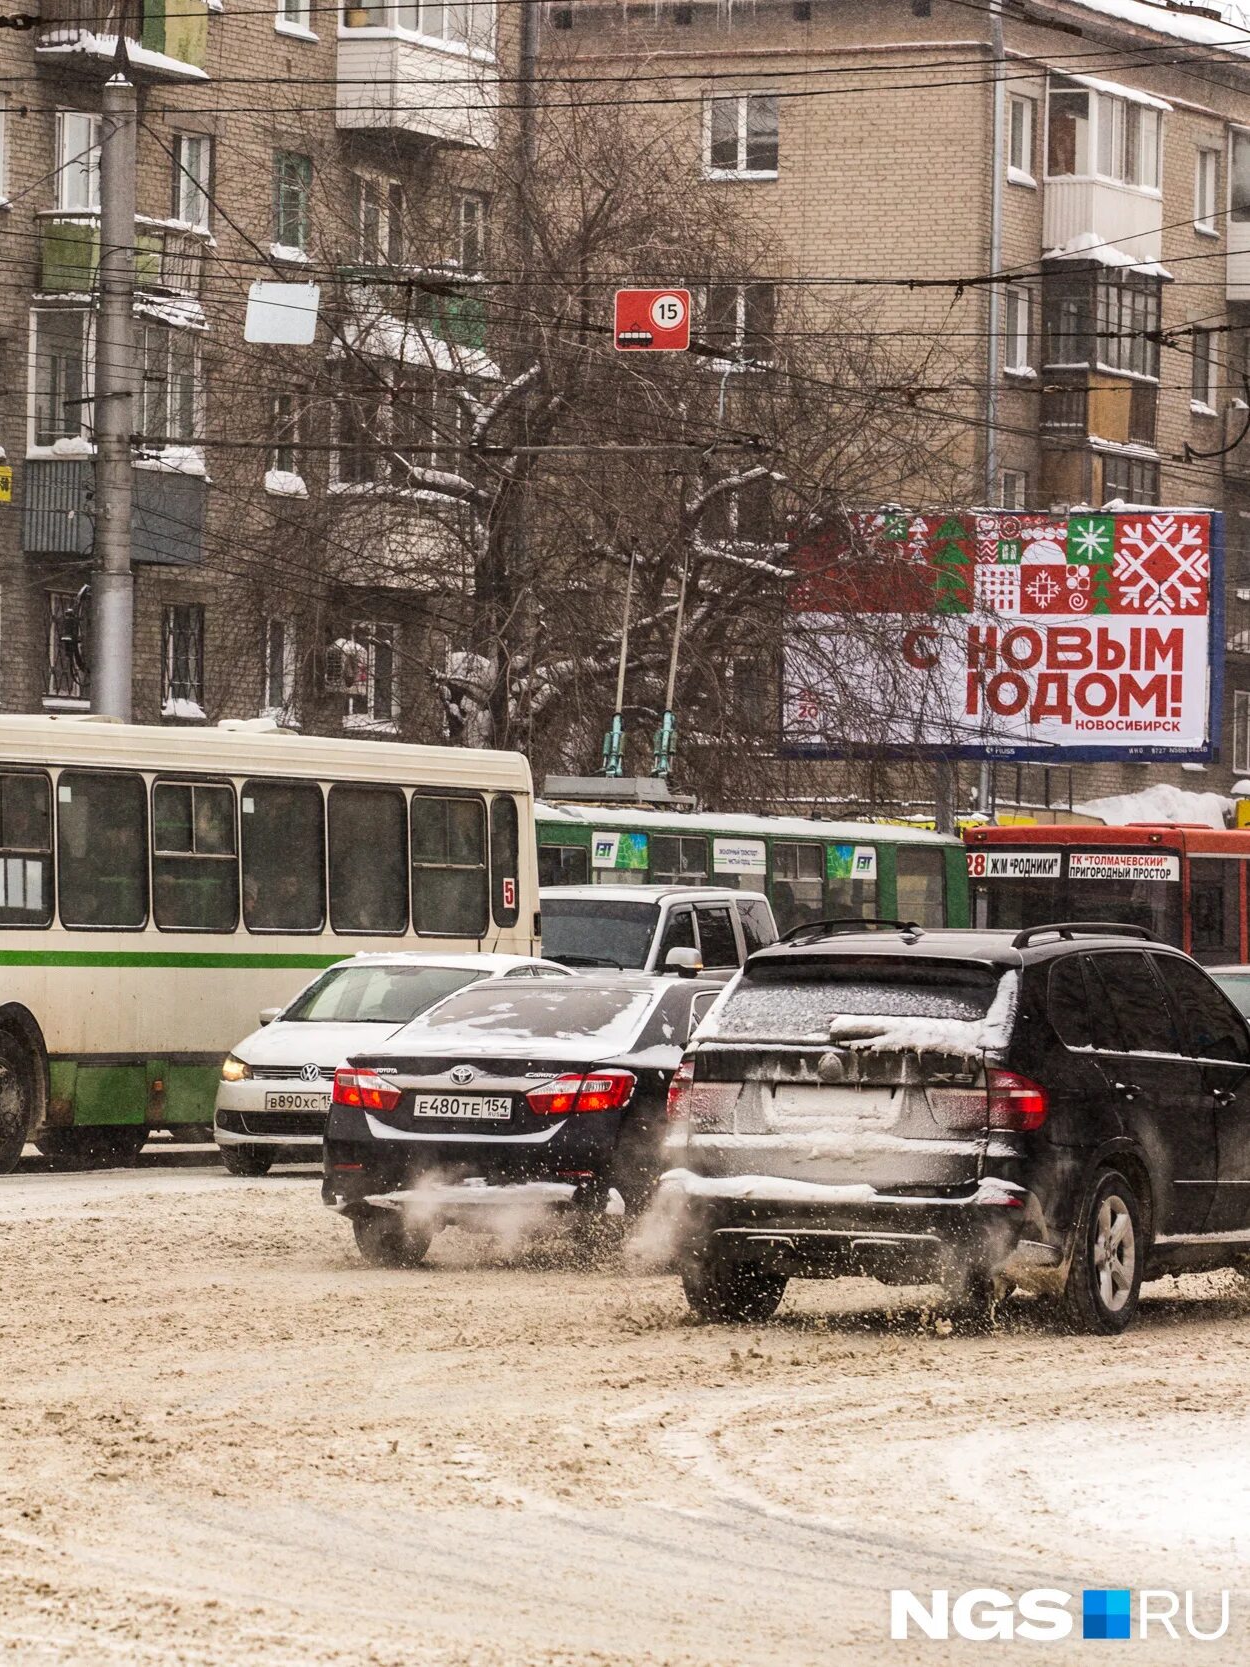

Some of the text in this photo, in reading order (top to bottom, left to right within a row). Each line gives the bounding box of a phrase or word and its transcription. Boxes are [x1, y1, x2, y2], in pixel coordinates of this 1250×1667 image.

[658, 304, 678, 320] 15
[967, 627, 1184, 671] НОВЫМ
[966, 672, 1183, 725] ГОДОМ!
[1075, 720, 1181, 732] НОВОСИБИРСК
[1071, 855, 1082, 865] ТК
[1069, 866, 1171, 880] ПРИГОРОДНЫЙ ПРОСТОР
[505, 881, 514, 905] 5
[484, 1099, 509, 1112] 154
